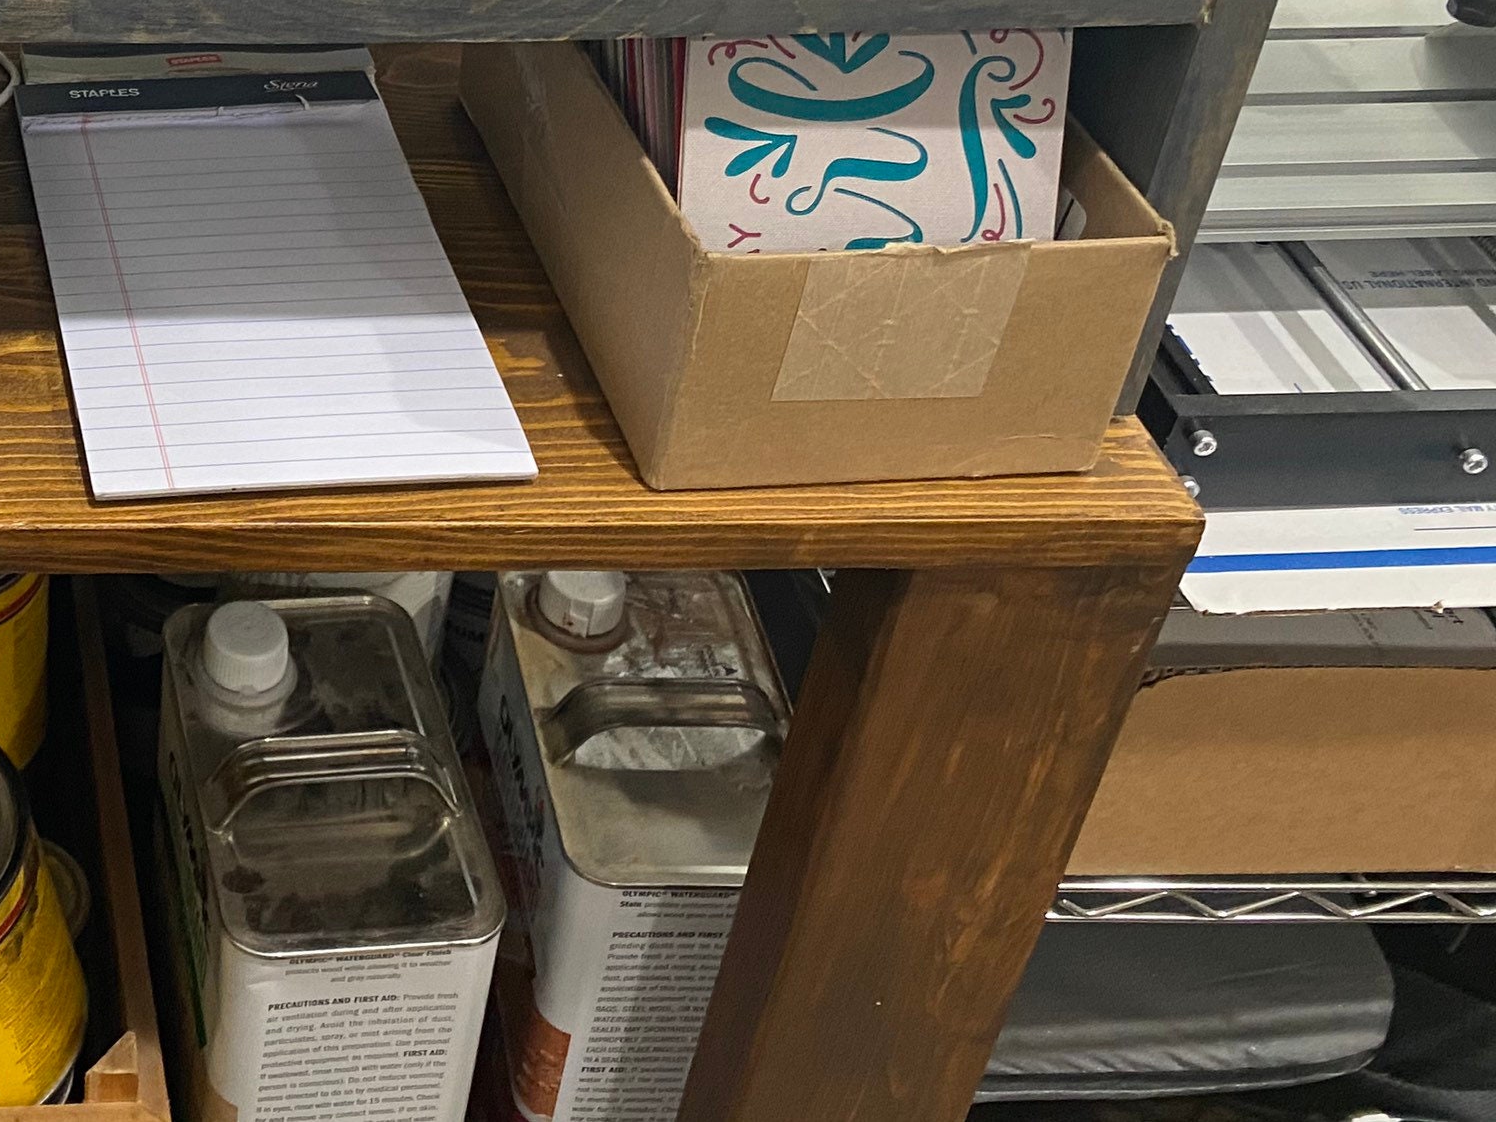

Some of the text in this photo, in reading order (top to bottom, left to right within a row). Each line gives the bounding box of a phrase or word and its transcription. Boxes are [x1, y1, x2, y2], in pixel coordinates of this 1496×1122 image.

[68, 87, 141, 100] STAPLES
[268, 999, 330, 1011] PRECAUTIONS
[354, 995, 378, 1003] FIRST
